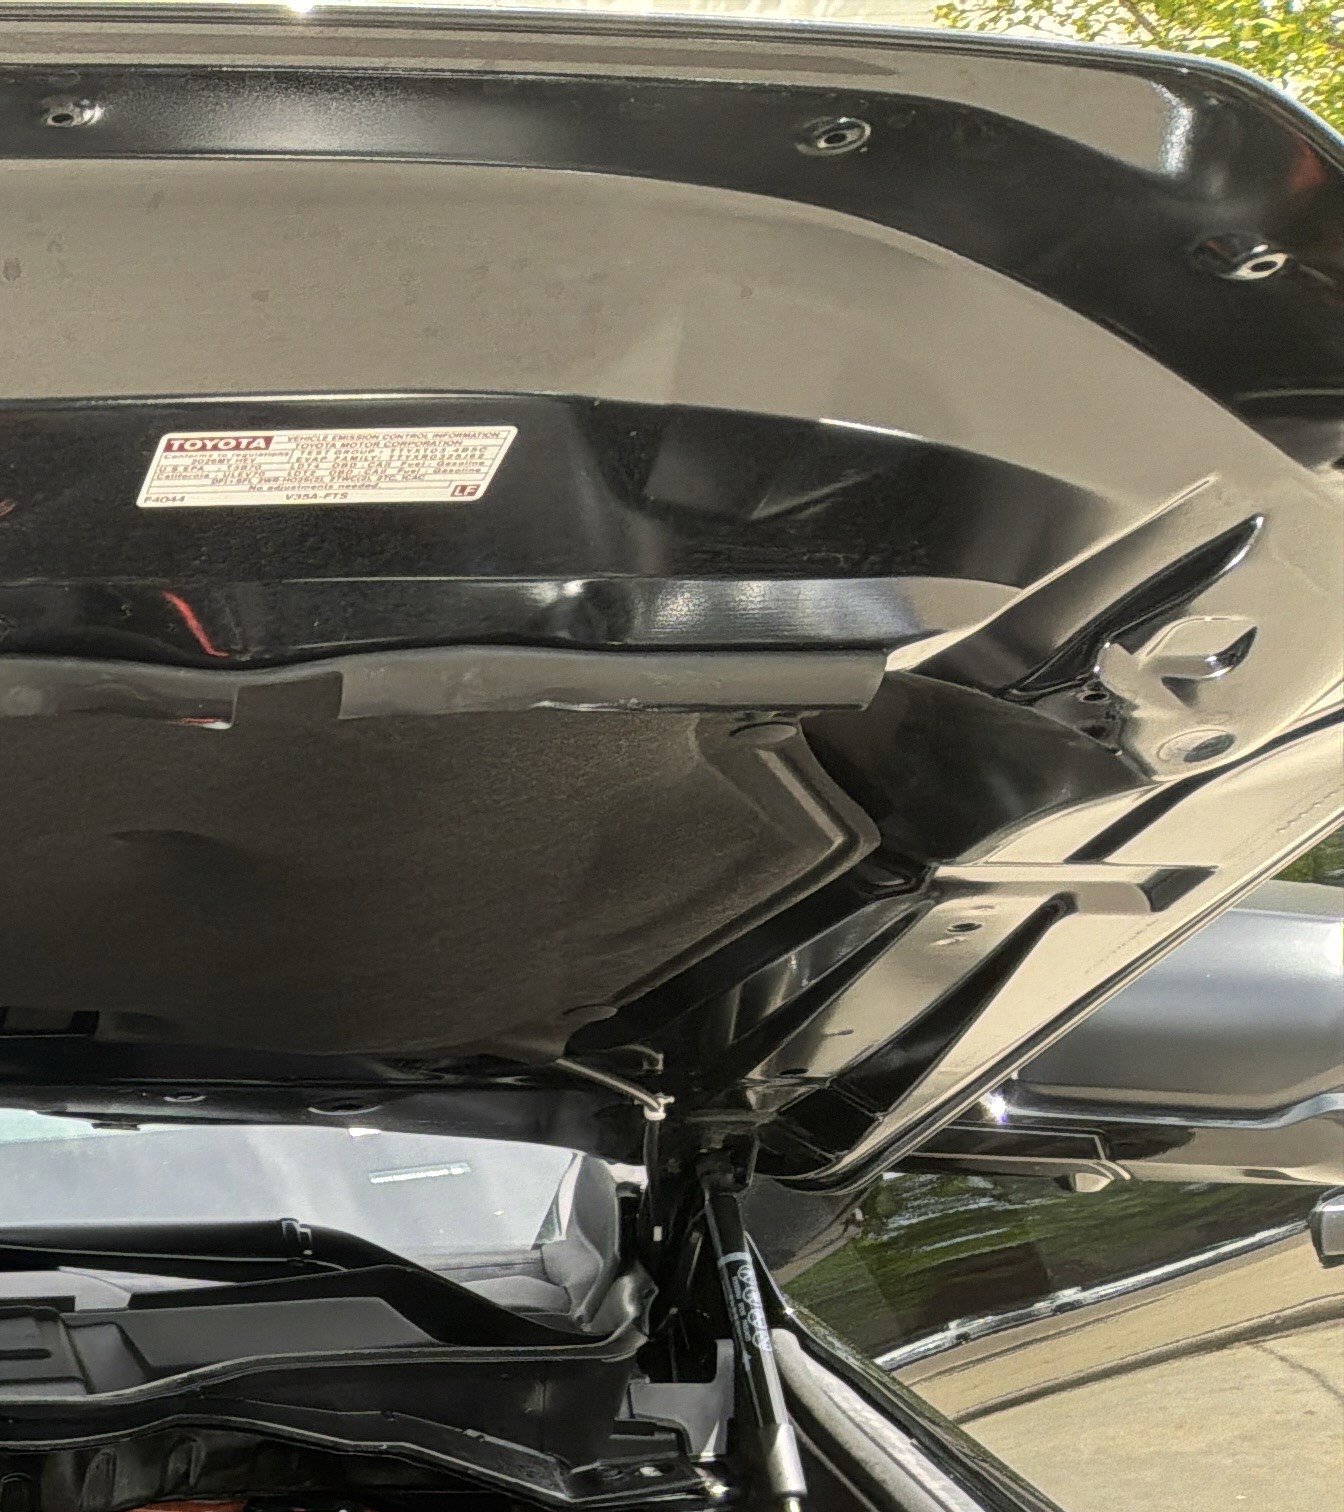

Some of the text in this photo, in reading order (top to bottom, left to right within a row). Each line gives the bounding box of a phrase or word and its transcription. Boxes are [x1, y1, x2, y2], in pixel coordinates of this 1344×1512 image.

[170, 438, 267, 451] TOYOTA
[295, 441, 337, 449] TOYOTA
[453, 485, 478, 496] LF
